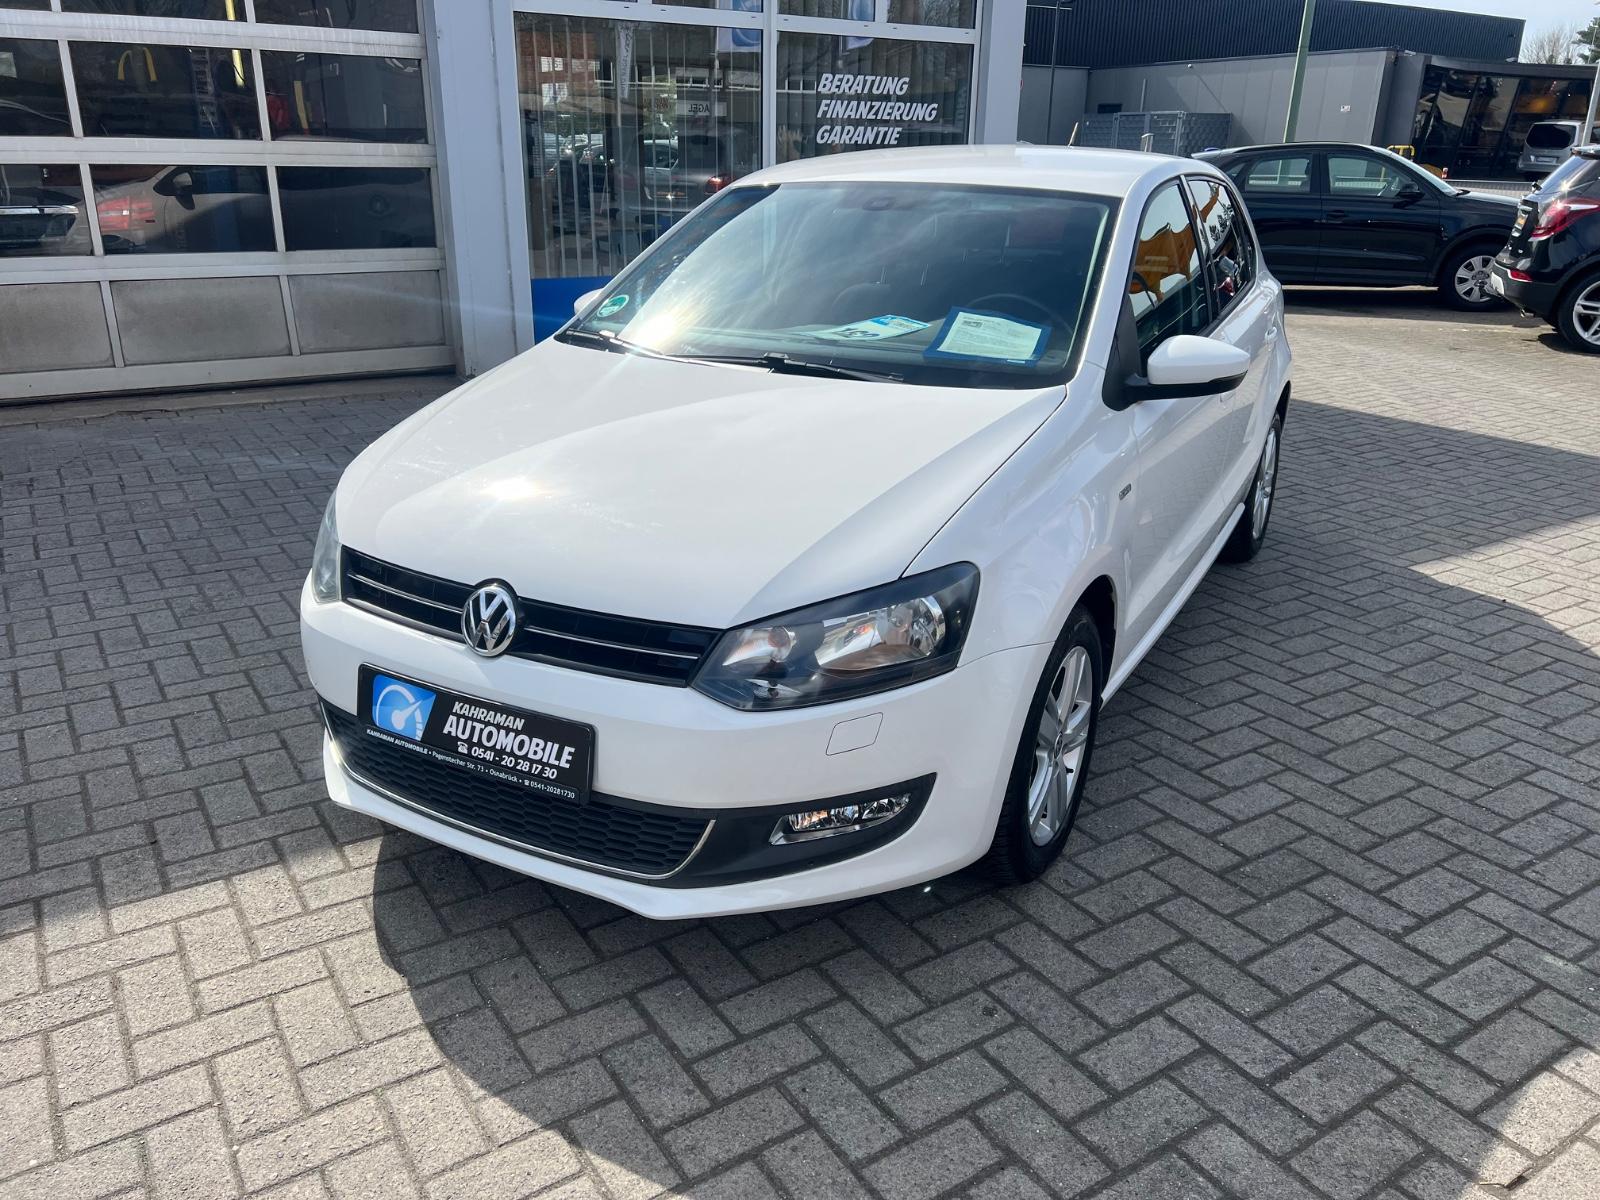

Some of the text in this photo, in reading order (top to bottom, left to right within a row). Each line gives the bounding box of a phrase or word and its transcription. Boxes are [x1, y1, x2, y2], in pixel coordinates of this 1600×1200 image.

[817, 73, 910, 95] BERATUNG
[816, 100, 939, 121] FINANZIERUNG
[816, 125, 903, 144] GARANTIE
[452, 701, 525, 731] KAHRAMAN
[366, 728, 395, 743] KAHRAMAN
[394, 739, 429, 755] AUTOMOBILE
[477, 765, 485, 773] 73
[489, 768, 518, 783] Osnabrück
[442, 714, 576, 769] AUTOMOBILE
[471, 746, 495, 761] 0541
[501, 755, 515, 767] 20
[516, 759, 530, 772] 28
[531, 763, 542, 775] 17
[542, 767, 557, 779] 30
